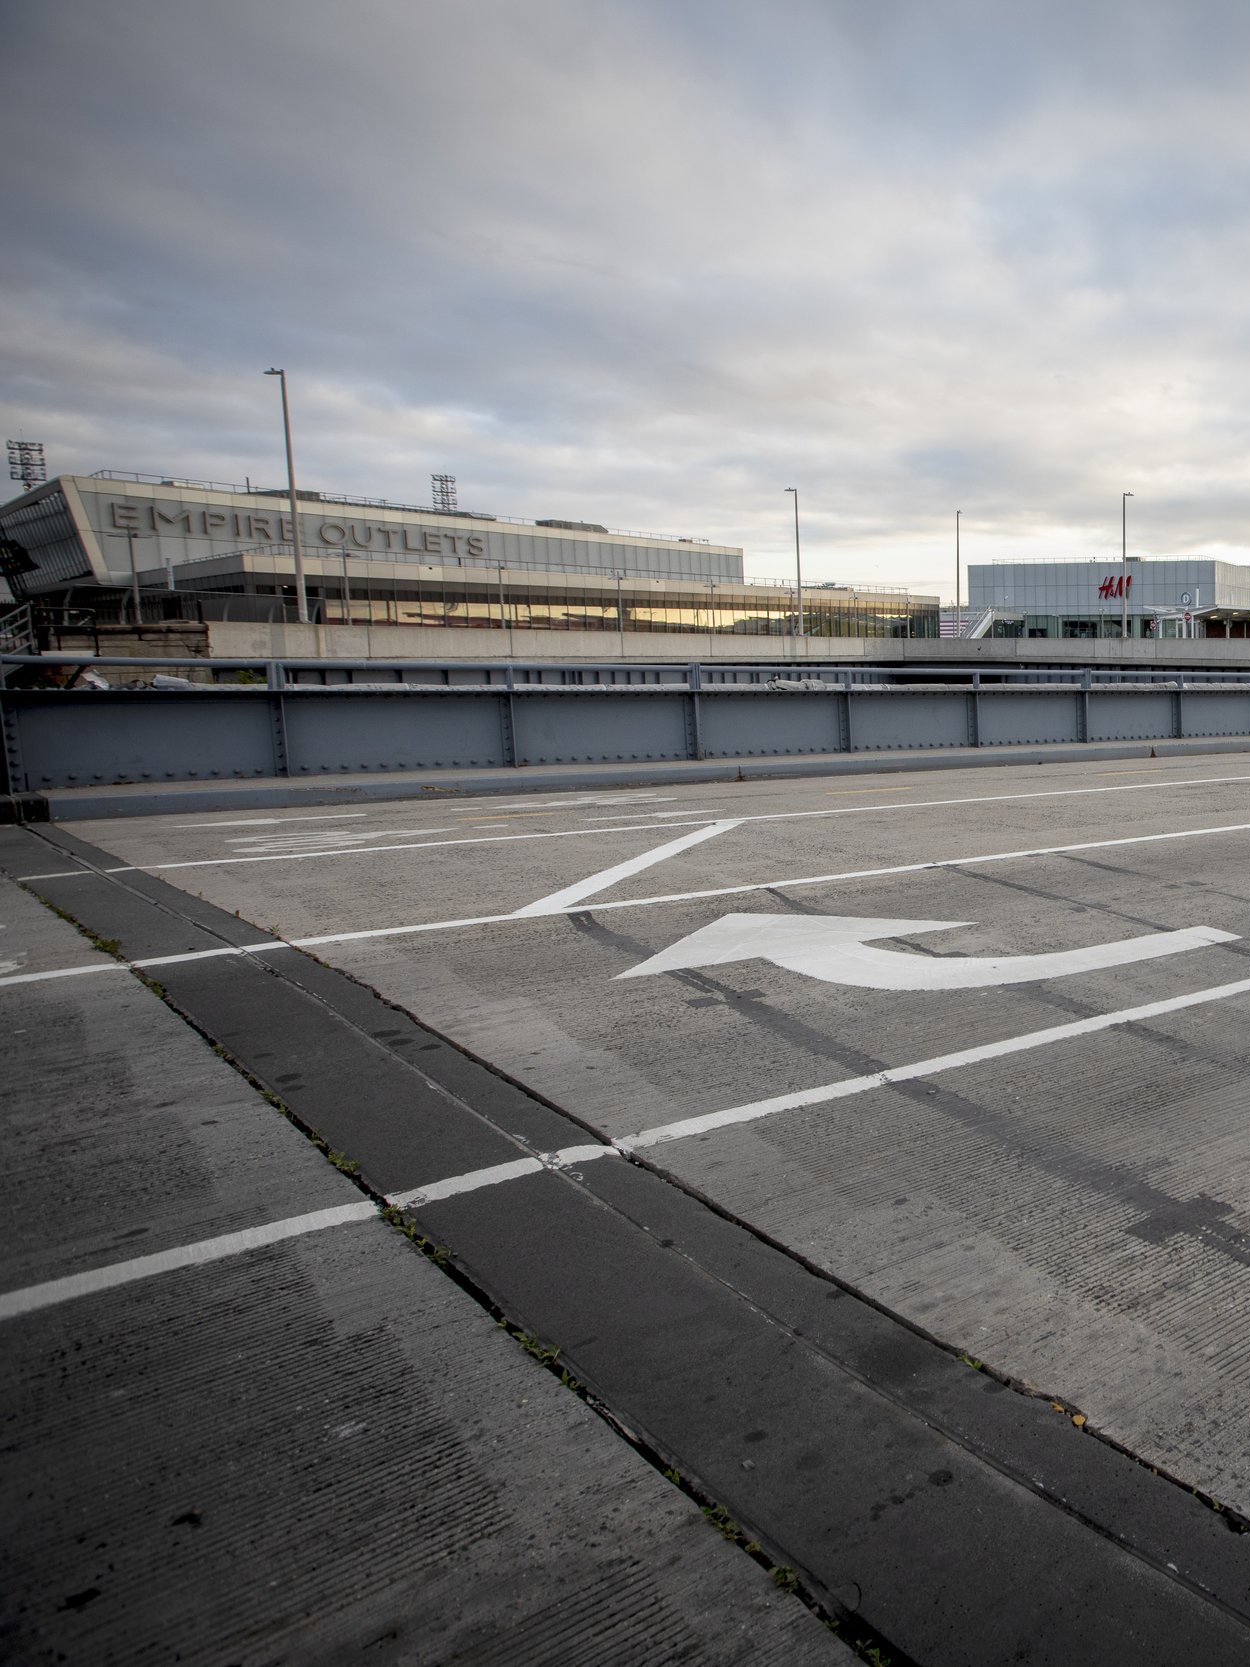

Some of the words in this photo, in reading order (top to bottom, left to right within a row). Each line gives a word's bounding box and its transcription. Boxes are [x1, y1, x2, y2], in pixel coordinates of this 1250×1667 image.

[111, 502, 303, 542] EMPIRE
[319, 522, 484, 556] OUTLETS
[1098, 575, 1132, 600] H&M
